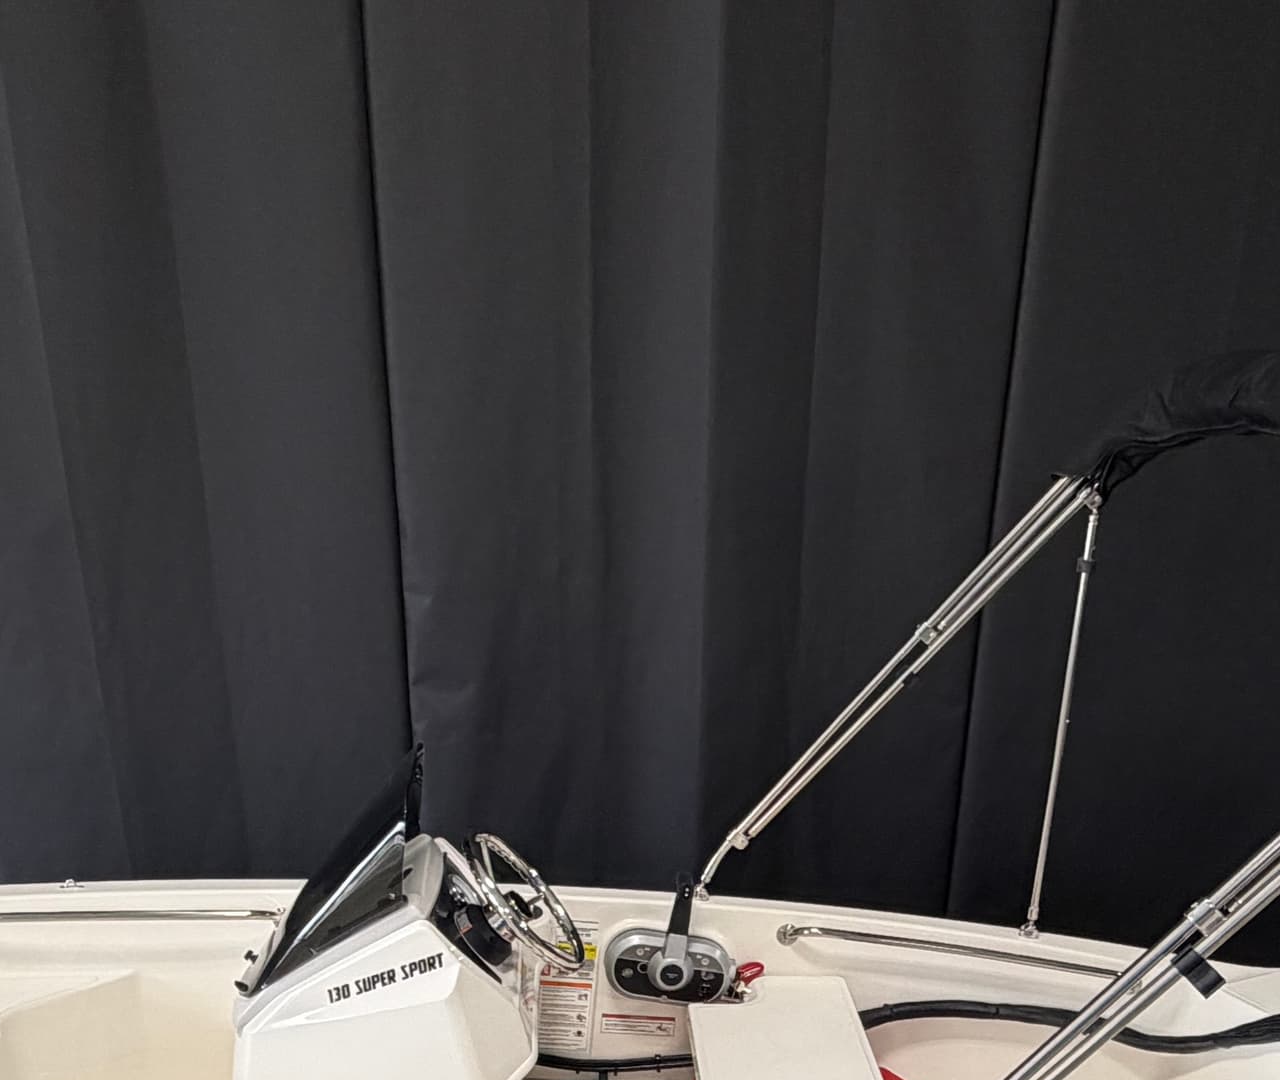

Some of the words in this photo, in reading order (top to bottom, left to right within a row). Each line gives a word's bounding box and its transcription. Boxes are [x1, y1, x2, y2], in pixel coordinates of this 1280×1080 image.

[327, 983, 351, 1004] 130
[354, 968, 397, 996] SUPER
[400, 952, 444, 980] SPORT
